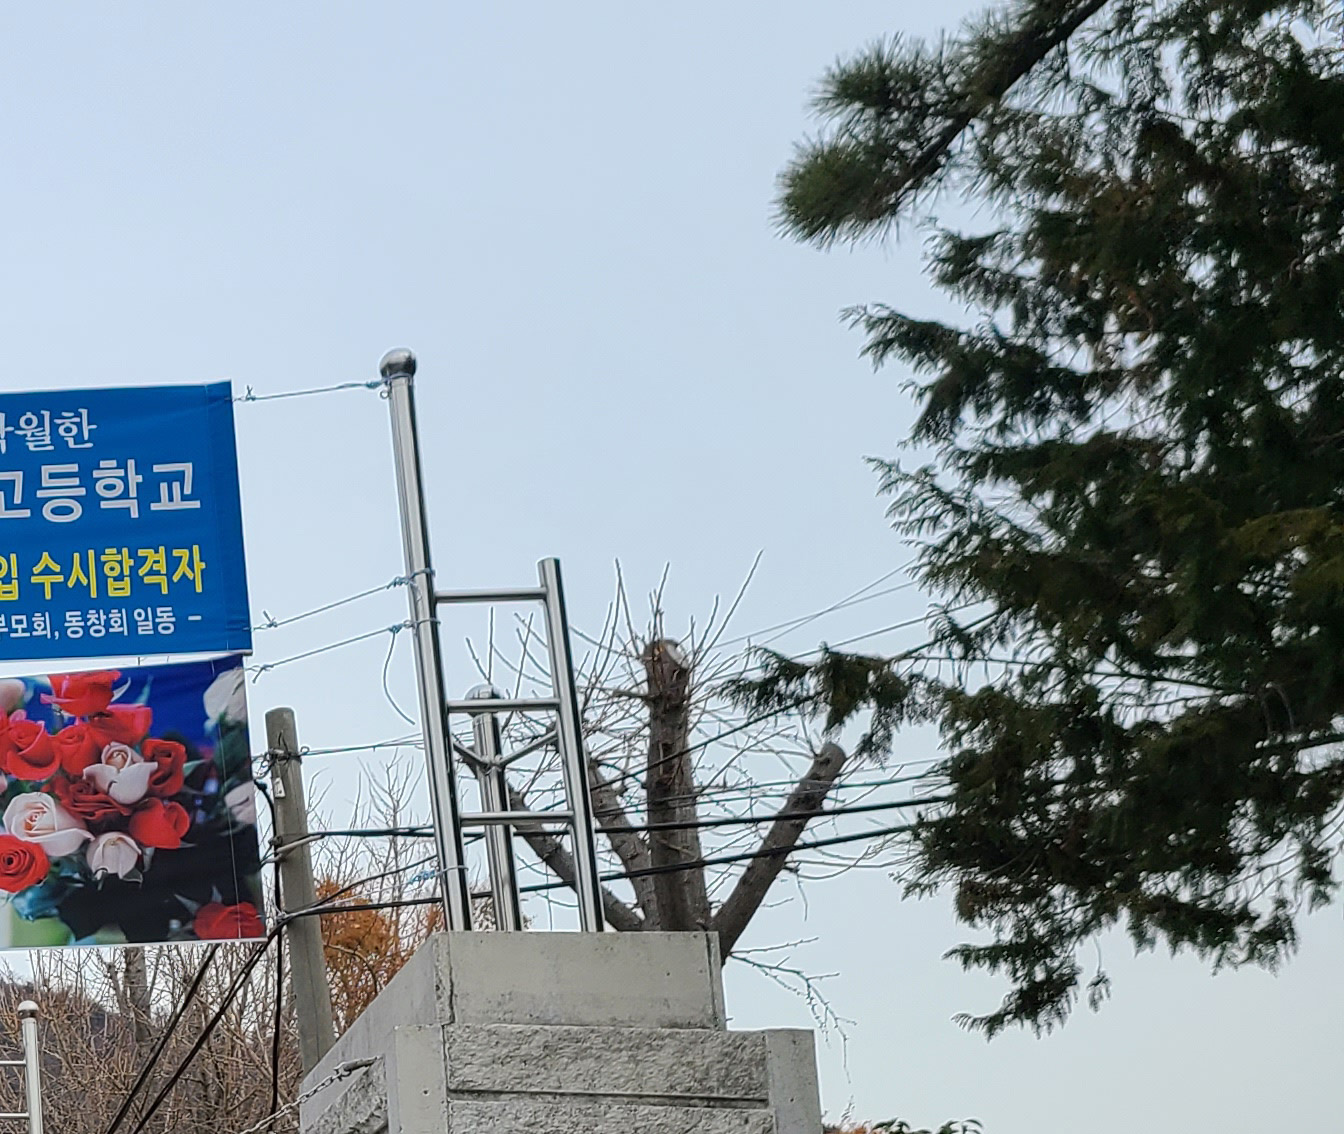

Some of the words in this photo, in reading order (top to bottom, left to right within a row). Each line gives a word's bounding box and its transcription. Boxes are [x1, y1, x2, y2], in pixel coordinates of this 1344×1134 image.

[31, 545, 205, 599] 수시합격자
[65, 609, 127, 638] 동창회
[134, 607, 175, 634] 일동
